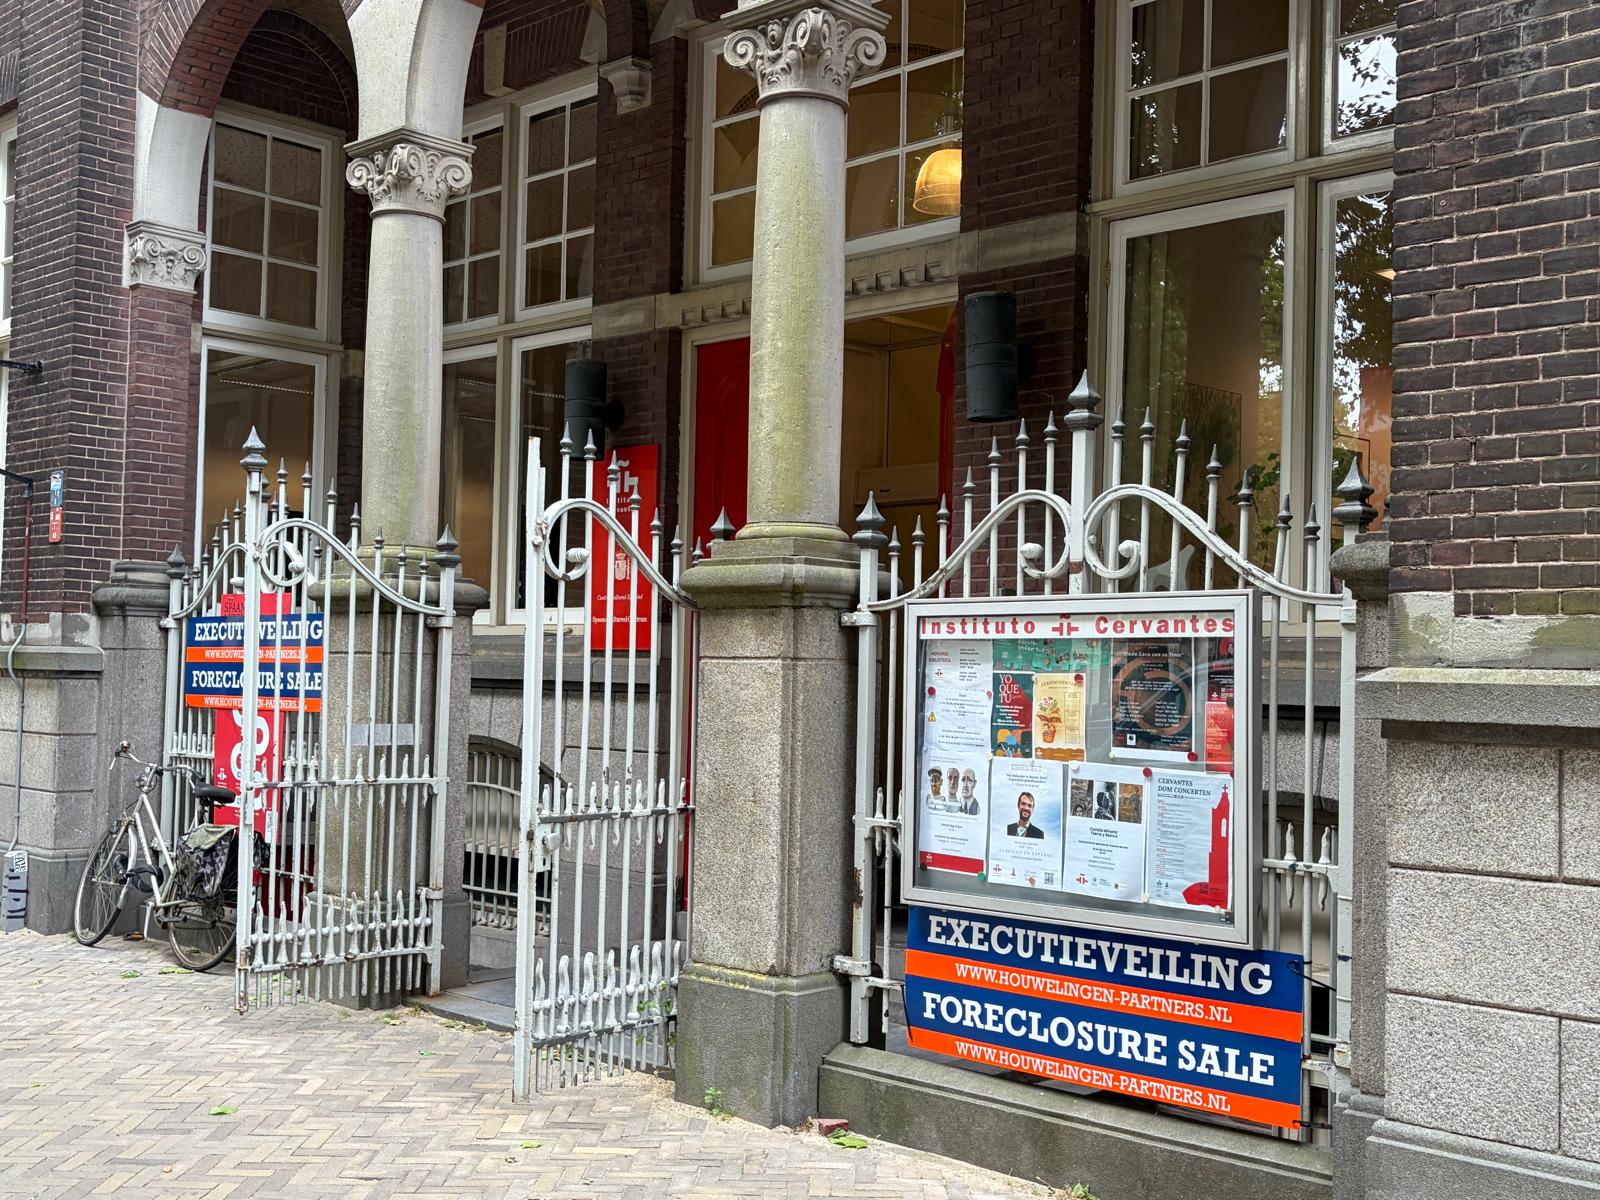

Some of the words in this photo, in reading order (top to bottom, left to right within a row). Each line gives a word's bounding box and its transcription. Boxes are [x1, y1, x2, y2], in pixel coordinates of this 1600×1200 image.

[194, 620, 323, 641] EXECUTVELING
[921, 617, 1036, 635] Instituto
[1095, 614, 1235, 635] Cervantes
[998, 684, 1020, 694] QUE
[999, 674, 1013, 684] YO
[1157, 785, 1173, 793] DOM
[1173, 787, 1211, 796] CONCERTEN
[1158, 777, 1193, 787] CERVANTES
[927, 915, 1273, 995] EXECUTIEVEILING
[955, 962, 1233, 1024] WWW.HOUWELINGEN-PARTNERS.NL
[922, 991, 1168, 1067] FORECLOSURE
[1177, 1039, 1275, 1087] SALE
[955, 1041, 1231, 1112] WWW.HOUWELINGEN-PARTNERS.NL
